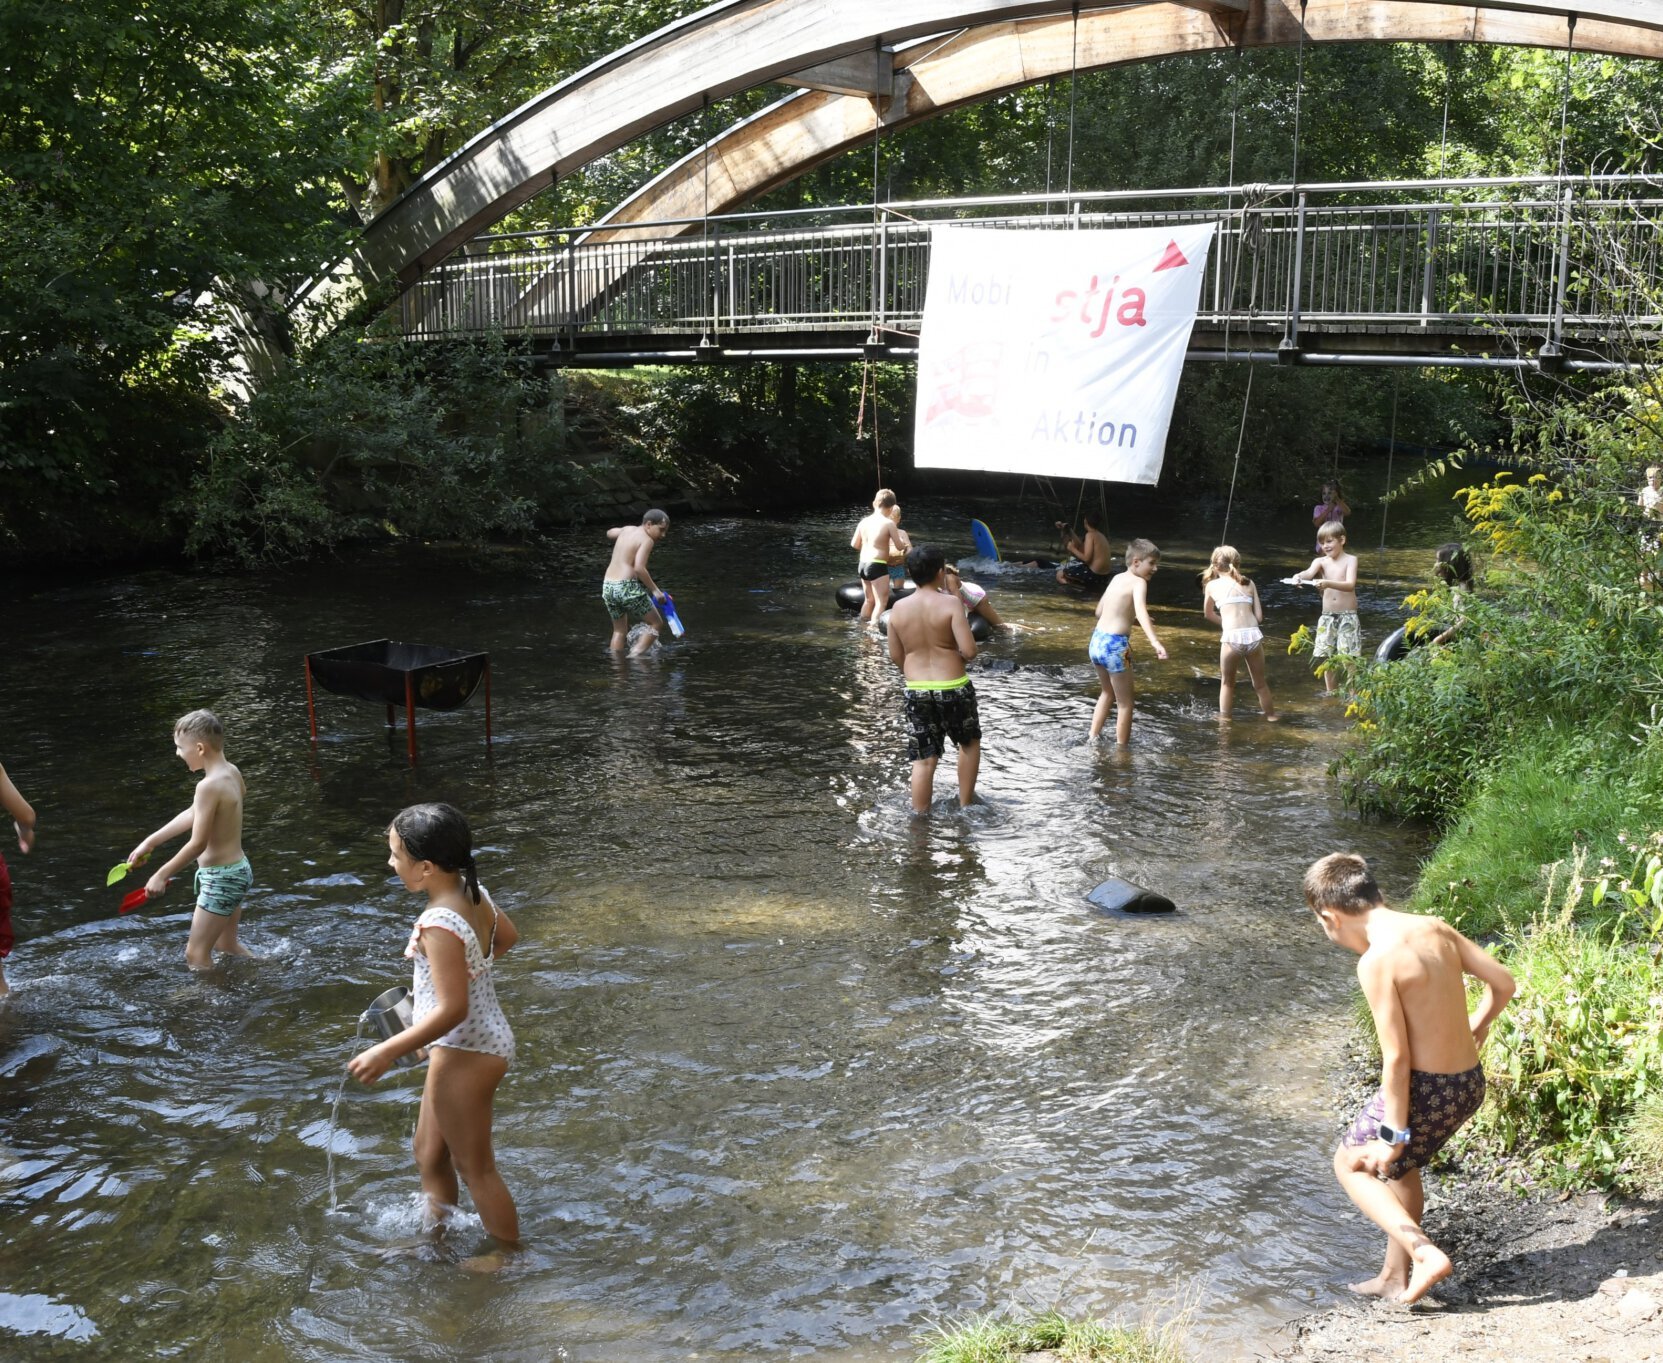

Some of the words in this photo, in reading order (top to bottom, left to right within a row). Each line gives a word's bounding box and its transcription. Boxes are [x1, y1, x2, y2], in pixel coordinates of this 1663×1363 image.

[948, 273, 1012, 305] Mobi
[1050, 274, 1147, 338] stja
[1031, 410, 1138, 449] Aktion
